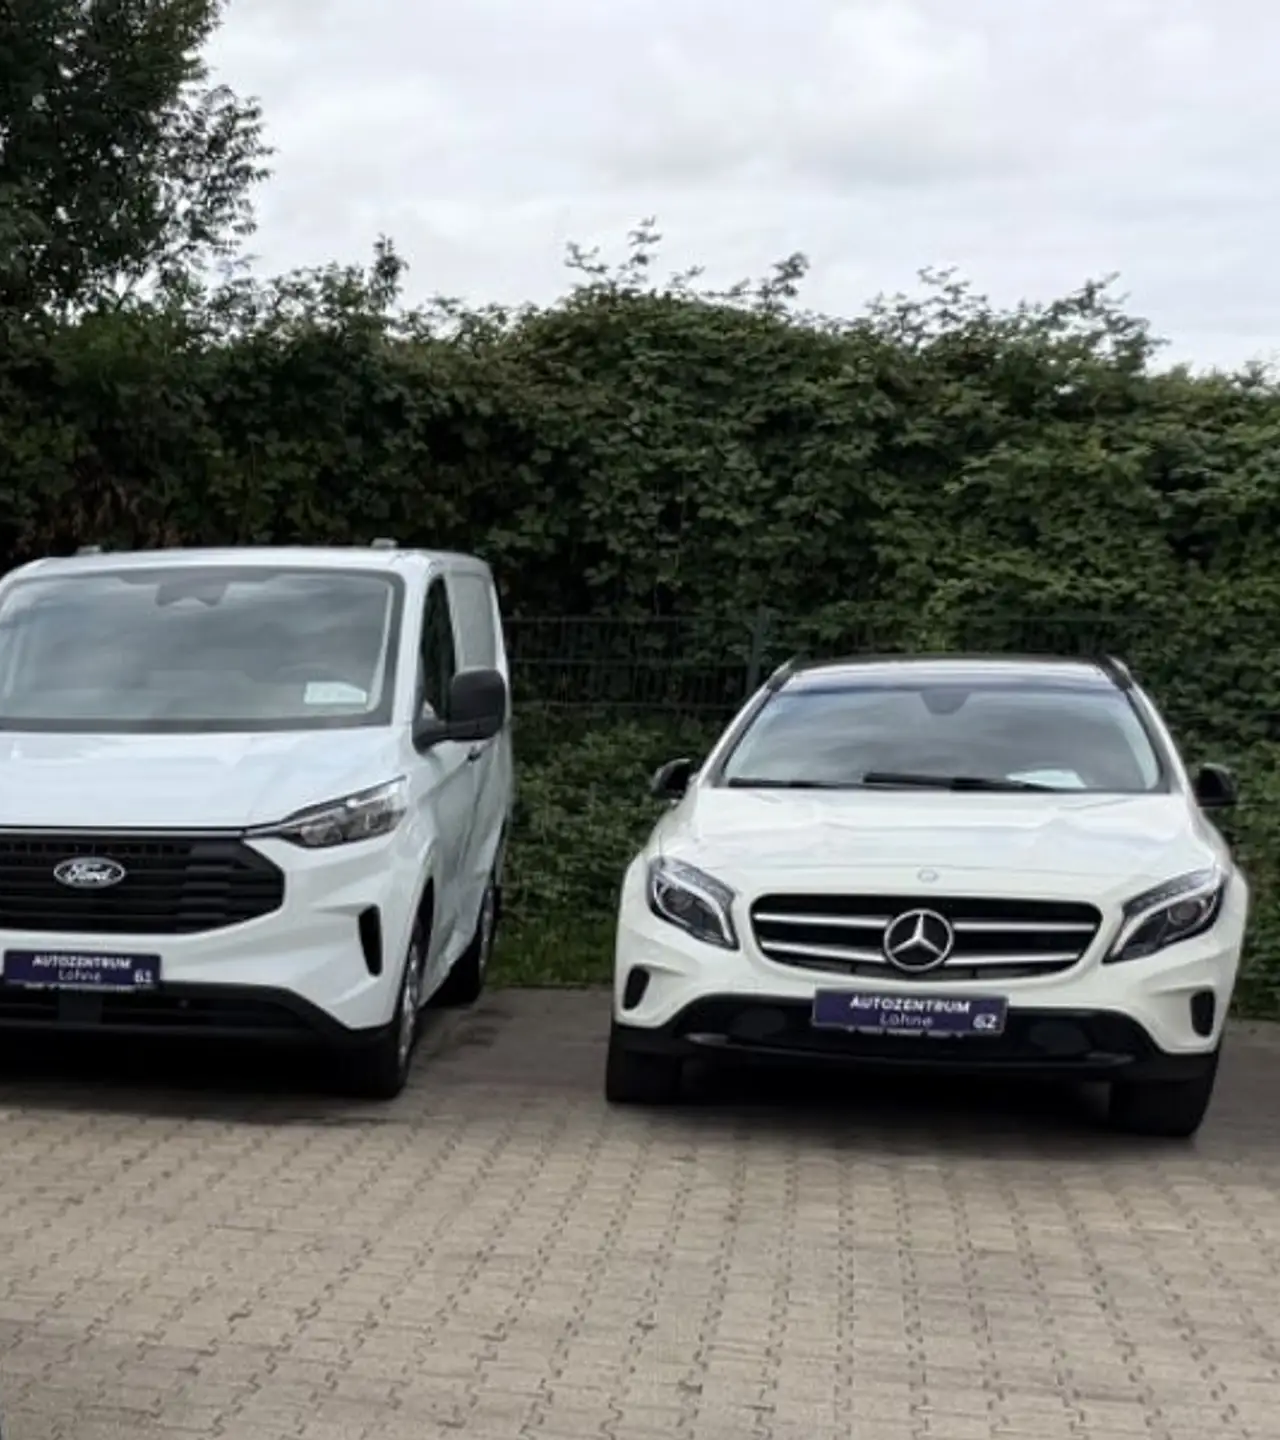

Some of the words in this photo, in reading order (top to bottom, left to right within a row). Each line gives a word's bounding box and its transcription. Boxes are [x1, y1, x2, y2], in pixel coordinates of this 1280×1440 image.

[31, 954, 133, 970] AUTOZENTRUM
[849, 994, 971, 1014] AUTOZENTRUM
[879, 1011, 934, 1028] Lohne
[972, 1013, 997, 1029] 62
